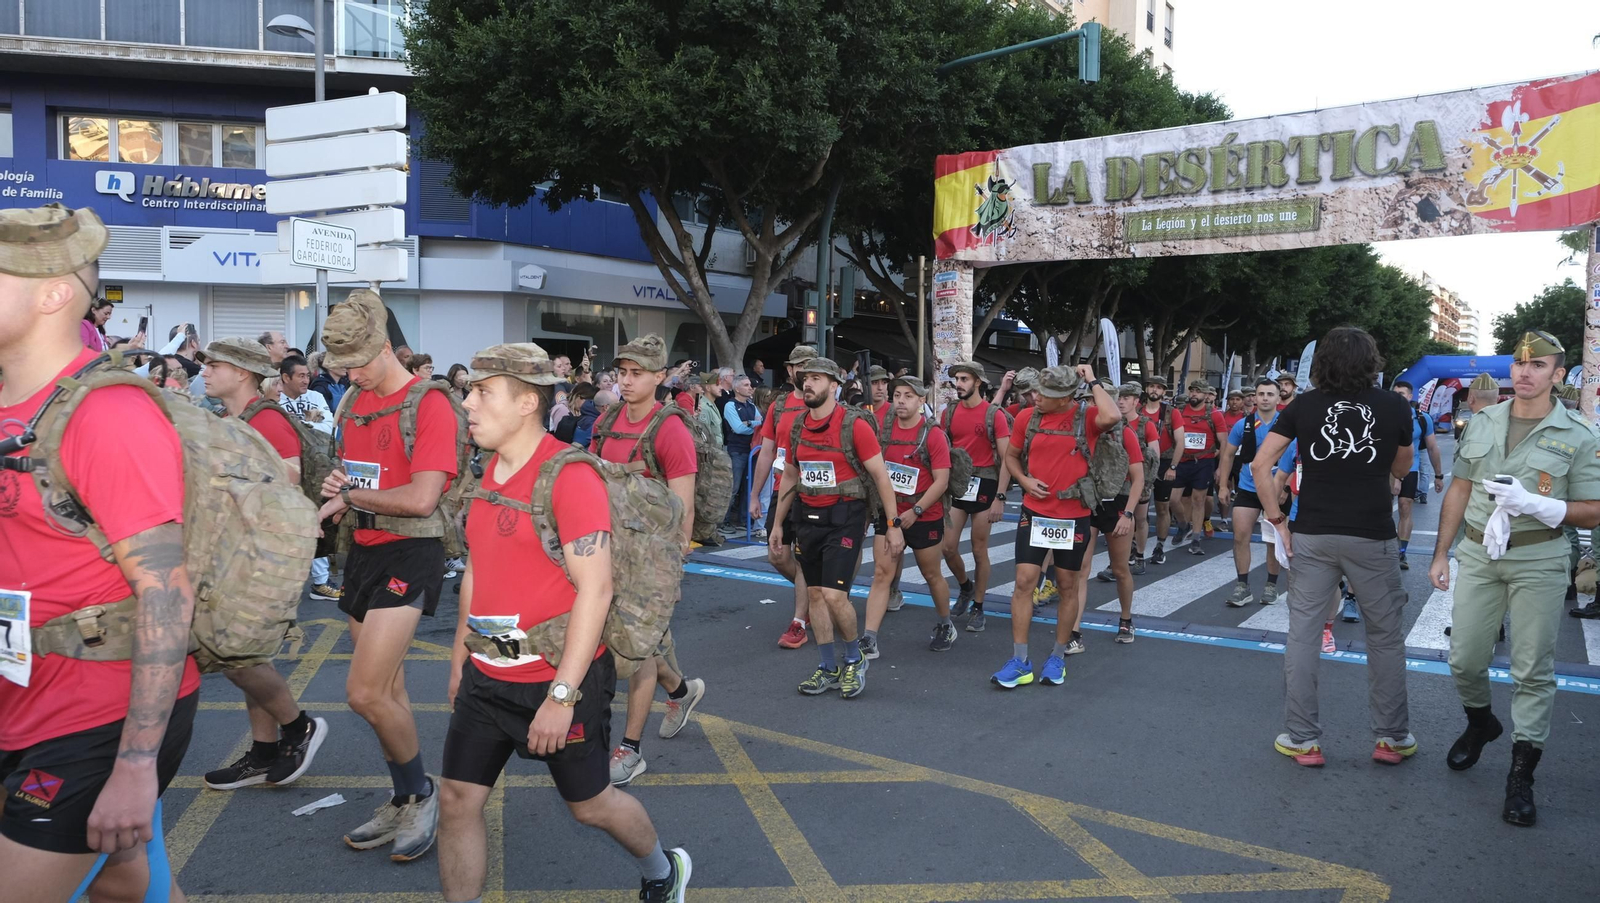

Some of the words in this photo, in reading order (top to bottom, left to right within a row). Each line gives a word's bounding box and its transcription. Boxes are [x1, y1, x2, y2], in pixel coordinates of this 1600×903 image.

[1032, 160, 1092, 204] LA
[1104, 120, 1448, 201] DESÉRTICA
[2, 186, 17, 197] de
[20, 187, 63, 199] Familia
[142, 198, 180, 209] Centro
[1142, 219, 1152, 231] La
[1156, 217, 1186, 231] Legión
[1190, 218, 1197, 229] y
[1201, 215, 1210, 227] el
[1214, 213, 1252, 226] desierto
[1257, 212, 1274, 223] nos
[1279, 210, 1297, 222] une
[312, 228, 353, 241] AVENIDA
[306, 238, 343, 253] FEDERICO
[297, 249, 325, 263] GARCÍA
[328, 253, 351, 267] LORCA
[806, 471, 829, 482] 4945
[890, 471, 912, 485] 4957
[1041, 527, 1068, 539] 4960
